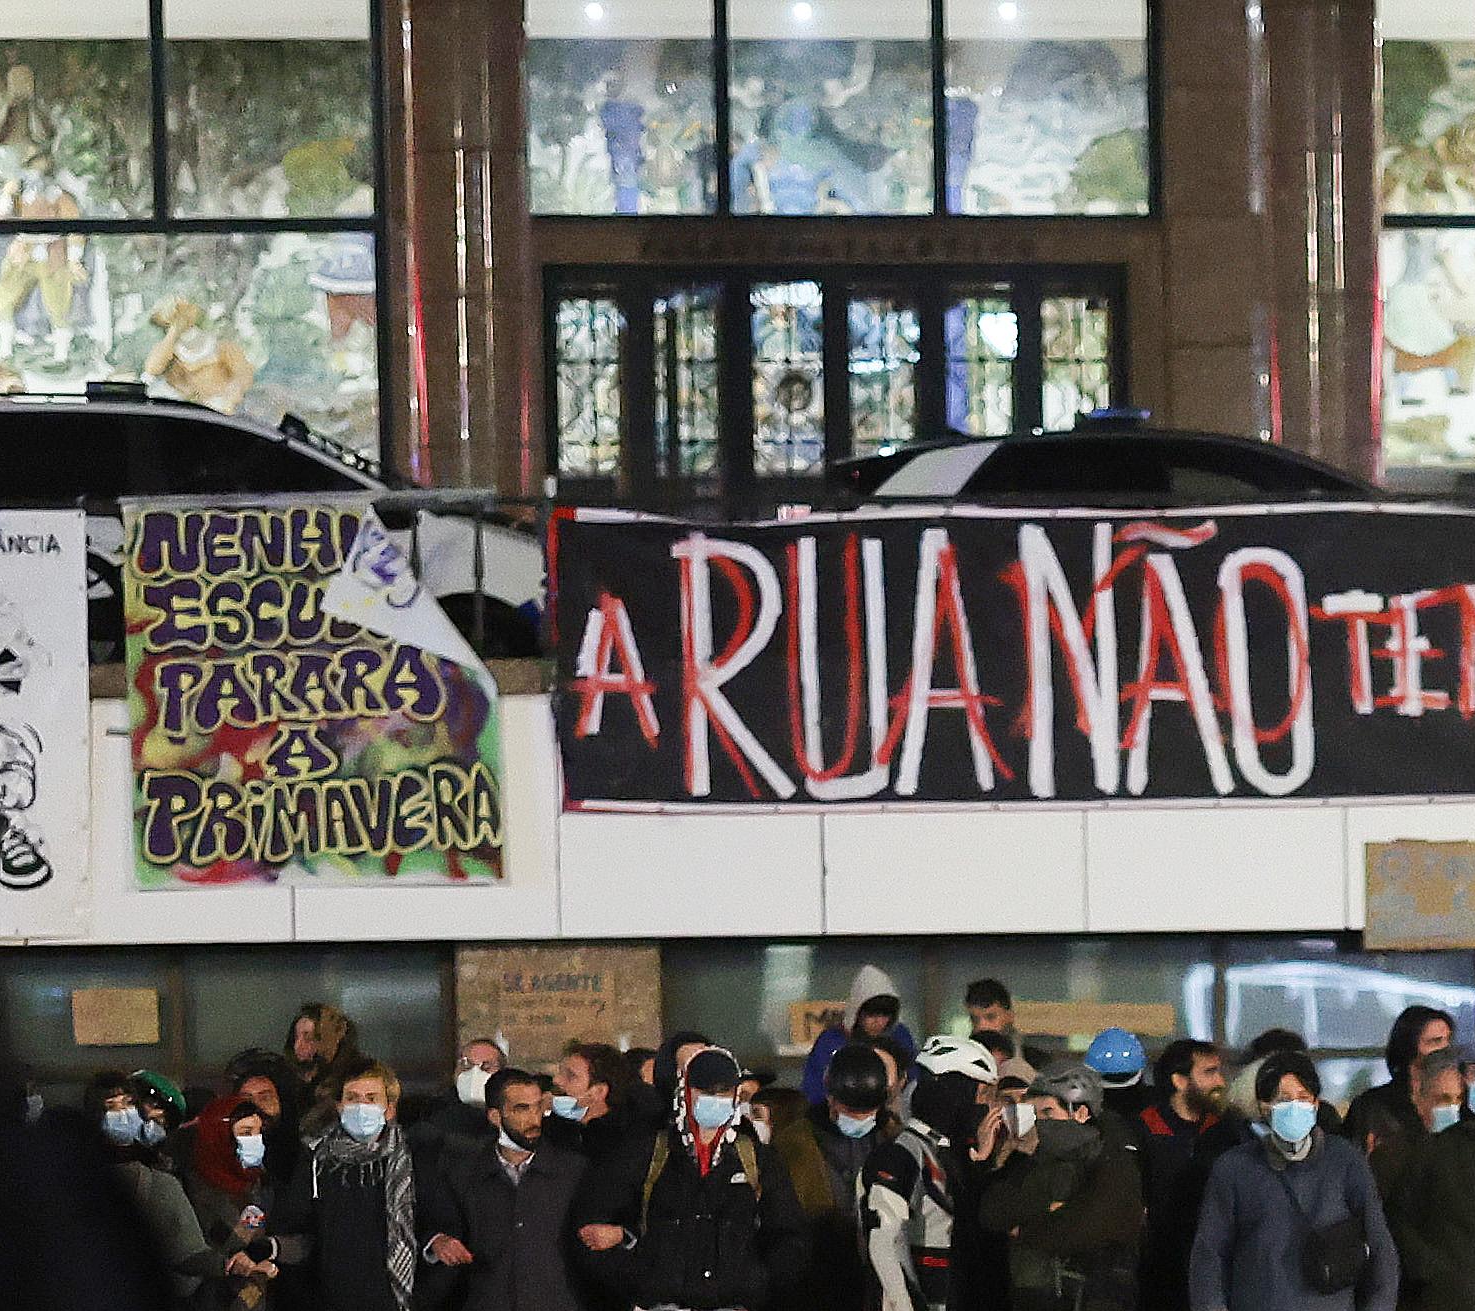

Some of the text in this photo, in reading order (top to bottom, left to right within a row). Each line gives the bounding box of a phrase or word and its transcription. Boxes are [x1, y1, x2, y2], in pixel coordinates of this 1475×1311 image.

[574, 591, 660, 749] A
[671, 526, 1017, 801] RUA
[999, 519, 1316, 798] NÃO
[264, 725, 341, 780] A
